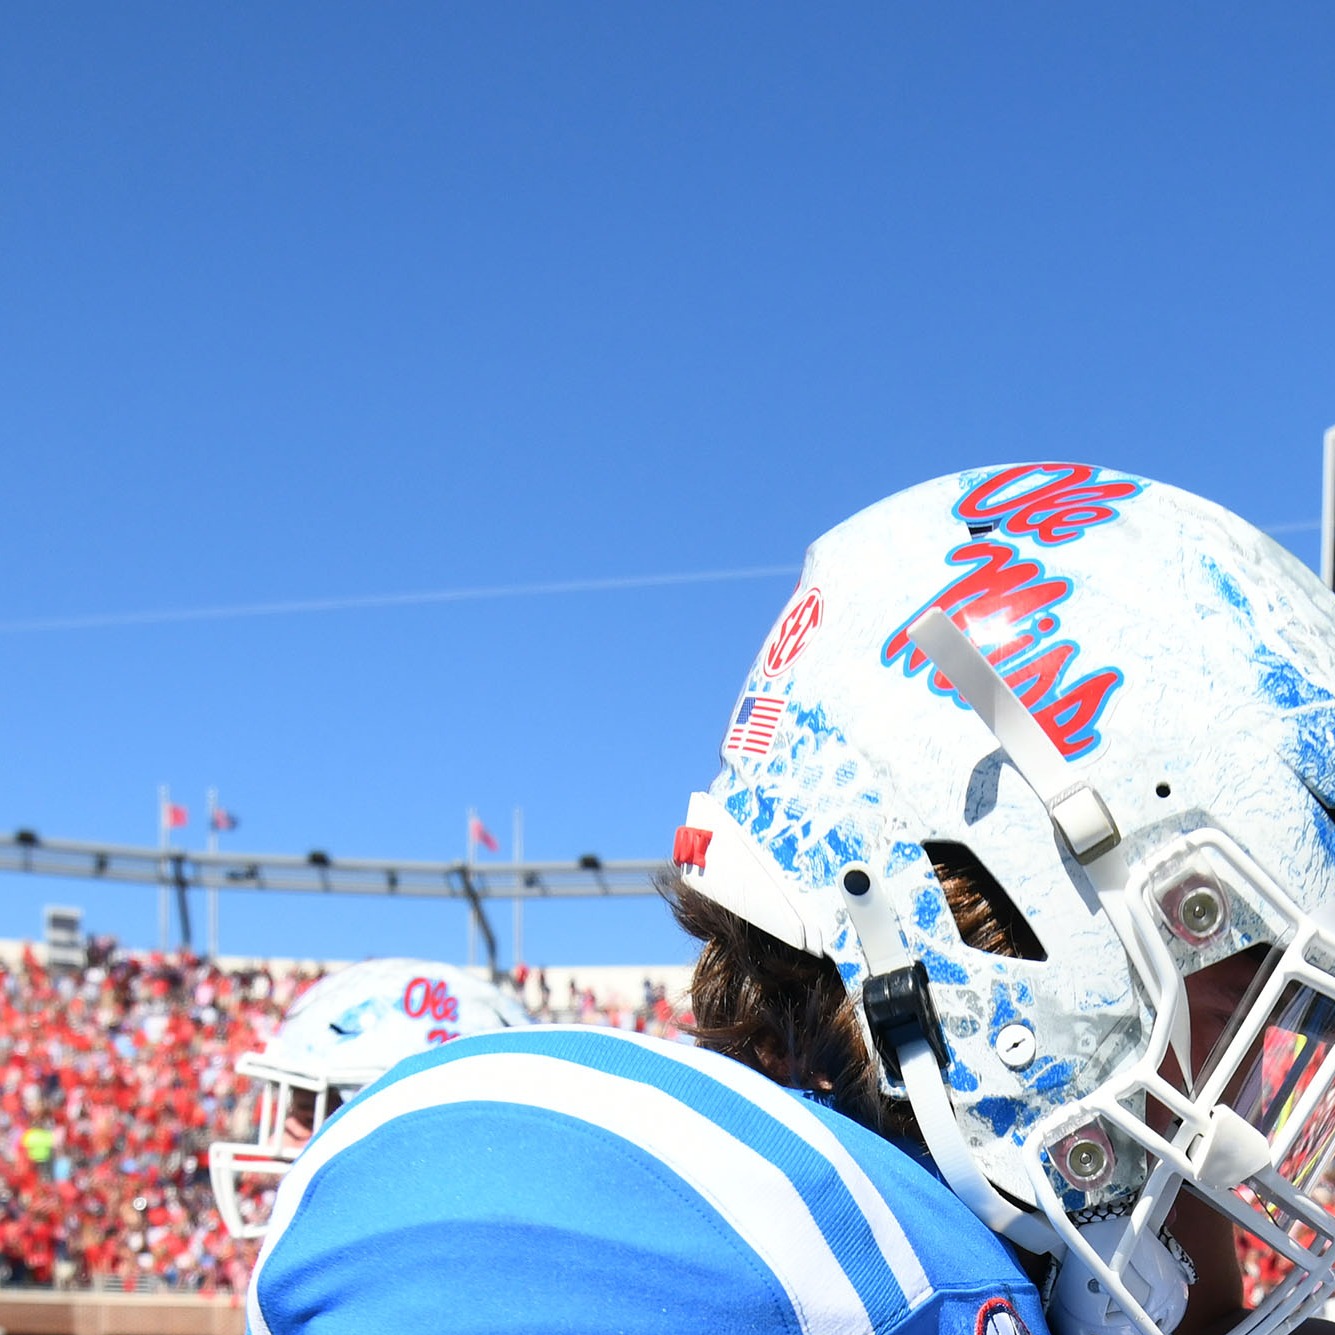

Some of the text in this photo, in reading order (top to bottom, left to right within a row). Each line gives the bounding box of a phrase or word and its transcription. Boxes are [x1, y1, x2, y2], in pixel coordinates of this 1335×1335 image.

[952, 461, 1144, 547] Ole
[766, 593, 821, 671] SEC
[881, 538, 1124, 763] Miss
[404, 976, 460, 1023] Ole
